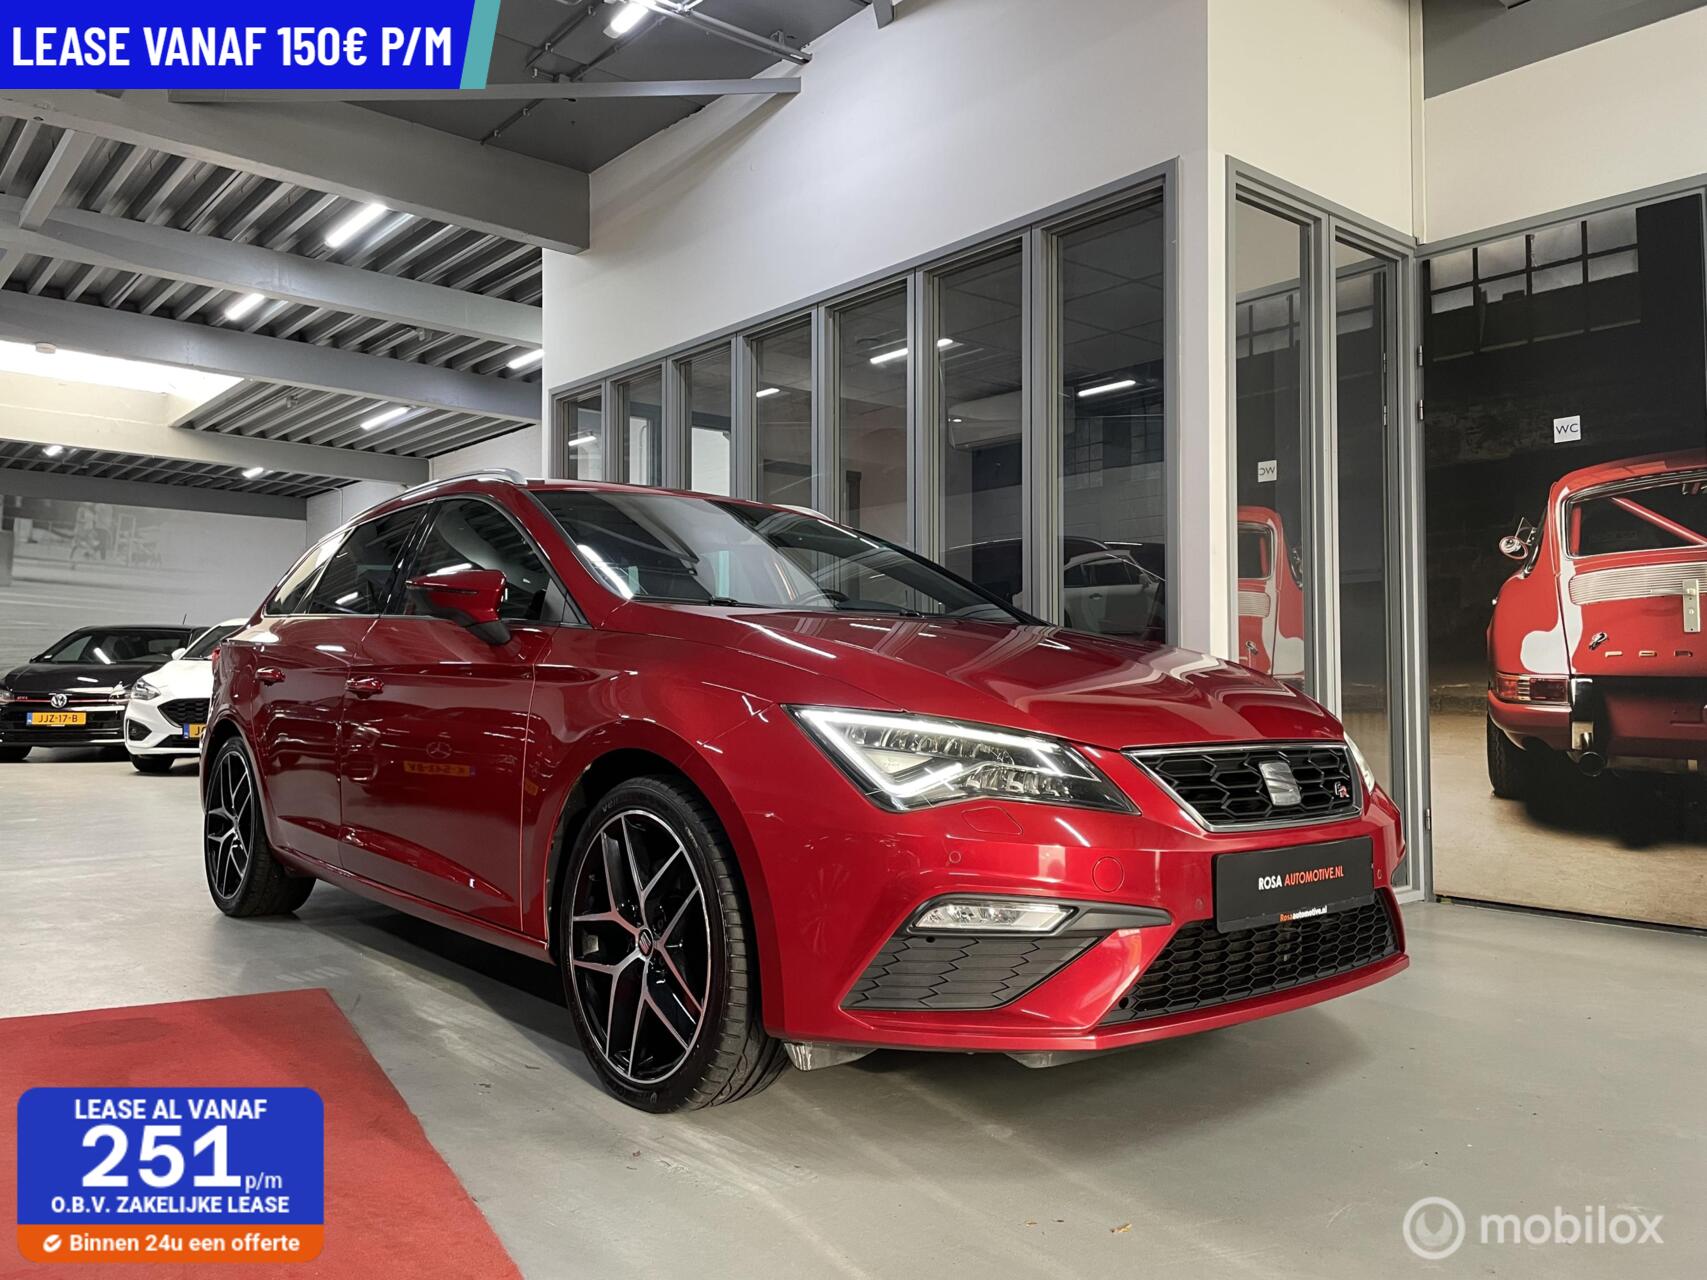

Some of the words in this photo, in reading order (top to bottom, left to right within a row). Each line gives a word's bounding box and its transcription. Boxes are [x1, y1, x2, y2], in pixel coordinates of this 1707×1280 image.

[1555, 423, 1579, 434] WC
[38, 714, 78, 723] JJZ-17-B
[1258, 875, 1283, 891] ROSA
[1284, 865, 1344, 887] AUTOMOTIVE.NL
